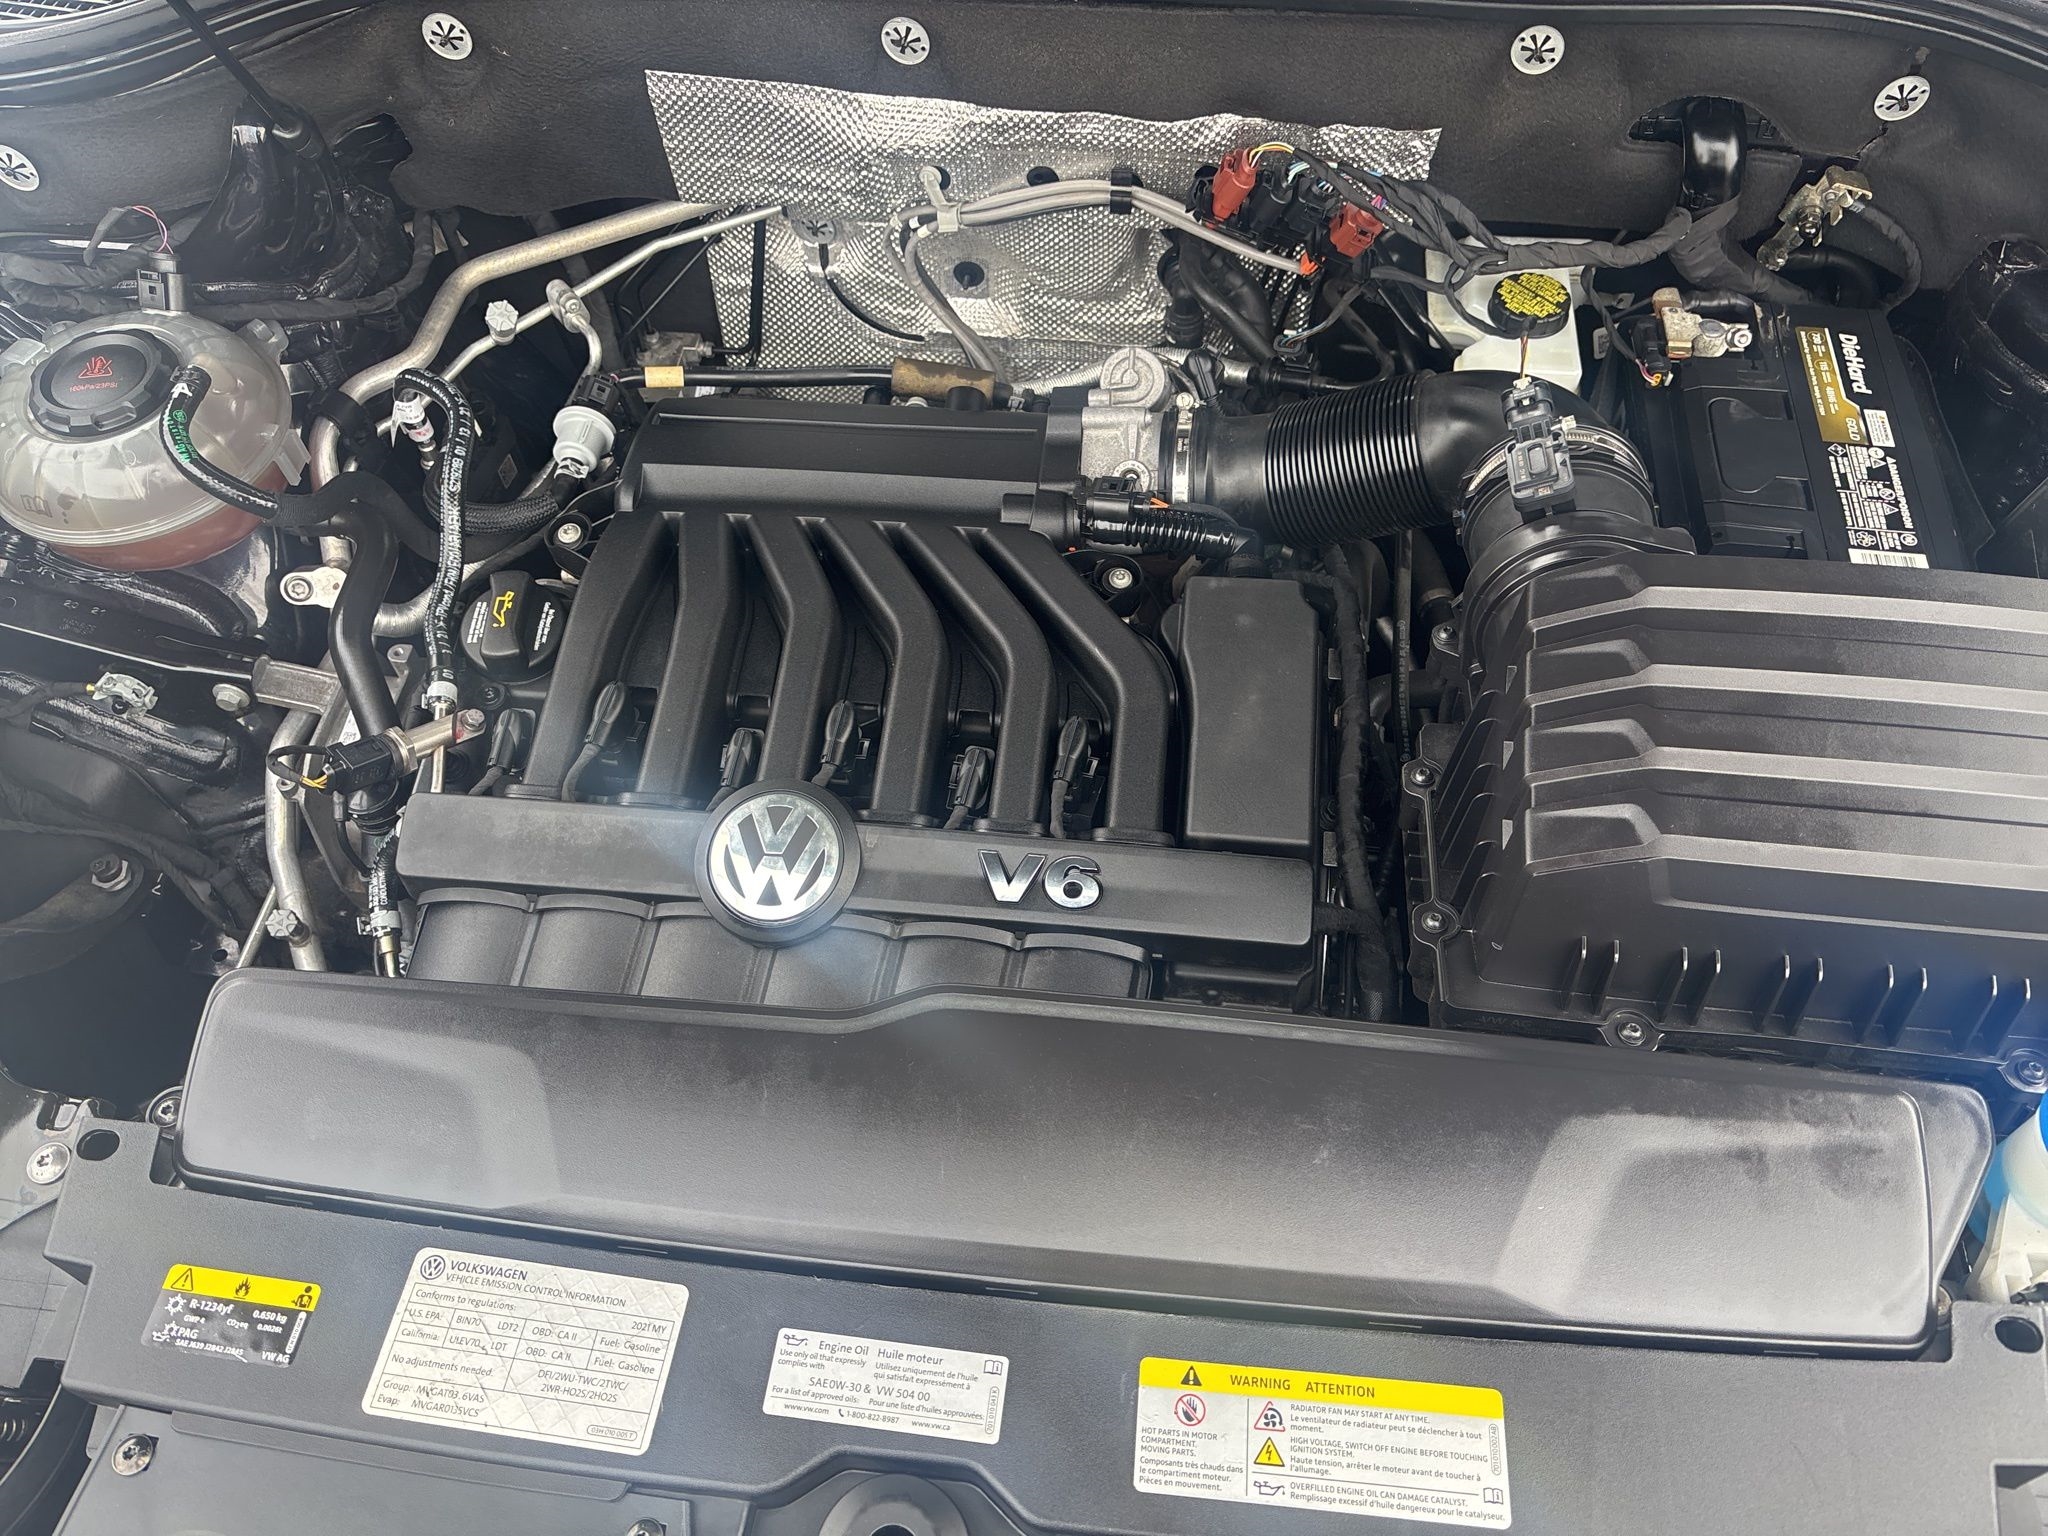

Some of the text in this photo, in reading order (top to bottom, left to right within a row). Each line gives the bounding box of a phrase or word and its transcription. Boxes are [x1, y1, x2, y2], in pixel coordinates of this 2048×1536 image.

[1839, 333, 1872, 394] DieHard
[1845, 418, 1860, 441] GOLD
[978, 849, 1103, 910] V6
[451, 1260, 528, 1280] VOLKSWAGEN
[446, 1272, 626, 1307] VEHICLE EMISSION CONTROL INFORMATION
[416, 1289, 455, 1302] Conforms
[468, 1298, 516, 1311] regulations:
[189, 1298, 287, 1324] R-1234yf 0.650 kg
[179, 1327, 199, 1339] PAG
[456, 1316, 661, 1354] BIN70 LDT2 OBD: CA Fuel: Gasoline
[632, 1321, 666, 1334] 2021 MY
[175, 1339, 188, 1347] SAE
[401, 1328, 440, 1340] California:
[525, 1347, 547, 1357] OBD:
[552, 1351, 563, 1360] CA
[594, 1357, 615, 1368] Fuel:
[618, 1361, 655, 1374] Gasoline
[819, 1341, 944, 1365] Engine Oil Huile moteur
[262, 1351, 290, 1363] VW AG
[392, 1354, 404, 1363] No
[406, 1357, 458, 1371] adjustments
[460, 1365, 493, 1376] needed.
[778, 1358, 808, 1368] complies
[794, 1351, 809, 1360] only
[819, 1354, 834, 1362] that
[835, 1357, 867, 1368] expressly
[874, 1372, 886, 1380] qui
[886, 1374, 914, 1383] satisfait
[875, 1362, 901, 1371] Utilisez
[902, 1367, 945, 1377] uniquement
[957, 1372, 978, 1382] l'huile
[383, 1380, 410, 1392] Group:
[809, 1377, 930, 1402] SAE0W-30 & VW 504 00
[1230, 1374, 1376, 1399] WARNING ATTENTION
[377, 1394, 399, 1405] Evap:
[772, 1385, 783, 1393] For
[790, 1388, 801, 1396] list
[811, 1391, 843, 1401] approved
[869, 1398, 885, 1406] Pour
[886, 1401, 899, 1409] une
[901, 1402, 914, 1411] liste
[916, 1404, 942, 1414] d'huiles
[943, 1409, 984, 1420] approuvées:
[784, 1403, 950, 1431] www.vw.com 1-800-822-8987 www.vw.ca
[1291, 1404, 1327, 1413] RADIATOR
[1361, 1411, 1383, 1419] START
[1158, 1428, 1180, 1437] PARTS
[1192, 1432, 1218, 1440] MOTOR
[1291, 1424, 1324, 1433] moment.
[1301, 1416, 1340, 1425] ventilateur
[1342, 1419, 1352, 1427] de
[1353, 1420, 1387, 1430] radiateur
[1418, 1426, 1457, 1437] déclencher
[1466, 1432, 1482, 1440] tout
[1141, 1436, 1197, 1448] COMPARTMENT.
[1141, 1445, 1196, 1457] MOVING PARTS.
[1290, 1437, 1308, 1445] HIGH
[1345, 1442, 1373, 1452] SWITCH
[1391, 1446, 1418, 1456] ENGINE
[1420, 1449, 1448, 1459] BEFORE
[1450, 1452, 1488, 1462] TOUCHING
[1290, 1445, 1324, 1454] IGNITION
[1140, 1456, 1183, 1468] Composants
[1200, 1462, 1225, 1472] chauds
[1226, 1465, 1243, 1473] dans
[1291, 1456, 1313, 1464] Haute
[1314, 1458, 1344, 1469] tension,
[1346, 1462, 1372, 1470] arrêter
[1412, 1468, 1432, 1476] avant
[1434, 1470, 1444, 1478] de
[1446, 1472, 1474, 1480] toucher
[1139, 1476, 1162, 1485] Pièces
[1175, 1480, 1222, 1491] mouvement.
[1148, 1468, 1200, 1479] compartiment
[1202, 1474, 1231, 1482] moteur.
[1290, 1482, 1335, 1493] OVERFILLED
[1337, 1486, 1364, 1496] ENGINE
[1366, 1489, 1378, 1498] OIL
[1380, 1491, 1396, 1499] CAN
[1398, 1492, 1429, 1503] DAMAGE
[1291, 1492, 1505, 1521] Remplissage excessif d'huile dangereux pour le catalyseur.
